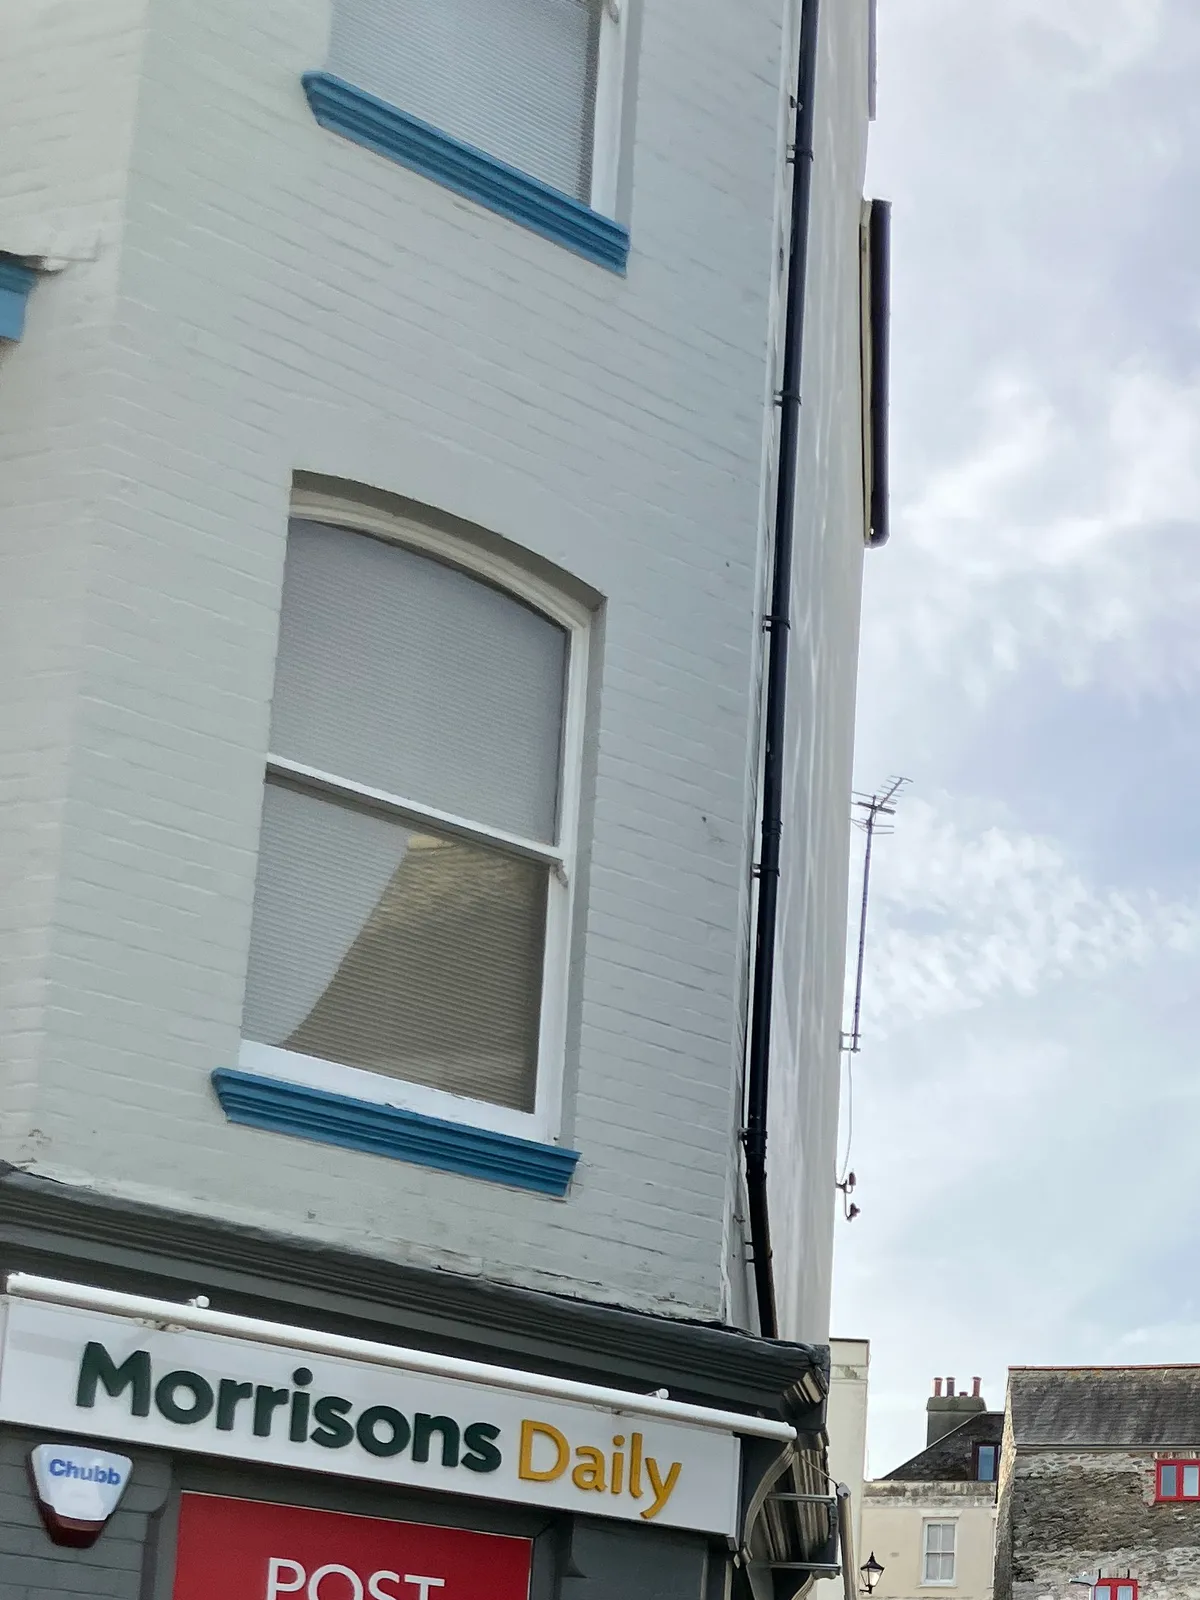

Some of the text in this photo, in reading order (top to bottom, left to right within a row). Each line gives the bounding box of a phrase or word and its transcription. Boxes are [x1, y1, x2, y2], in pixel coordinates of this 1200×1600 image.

[50, 1458, 121, 1485] Chubb
[76, 1341, 682, 1519] Morrisons Daily
